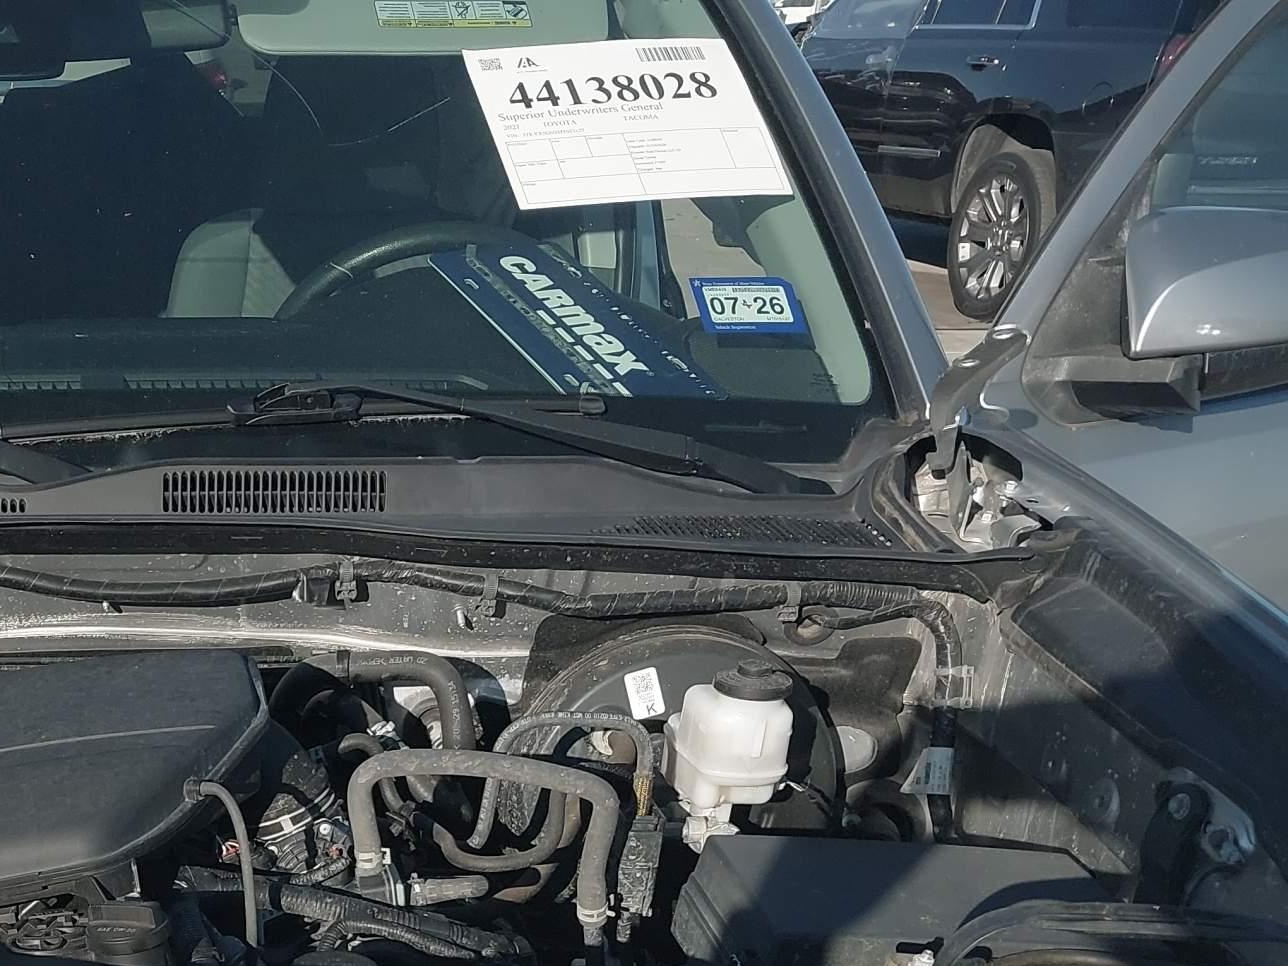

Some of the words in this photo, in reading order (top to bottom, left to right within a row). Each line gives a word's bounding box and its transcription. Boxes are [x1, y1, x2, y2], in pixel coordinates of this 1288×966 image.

[509, 71, 718, 109] 44138028
[498, 111, 545, 122] Superior
[547, 105, 619, 117] Underwriters
[621, 101, 664, 112] General
[543, 119, 577, 128] TOYOTA
[623, 114, 659, 122] TACOMA
[709, 296, 739, 315] 07
[753, 296, 785, 315] 26
[646, 702, 658, 716] K
